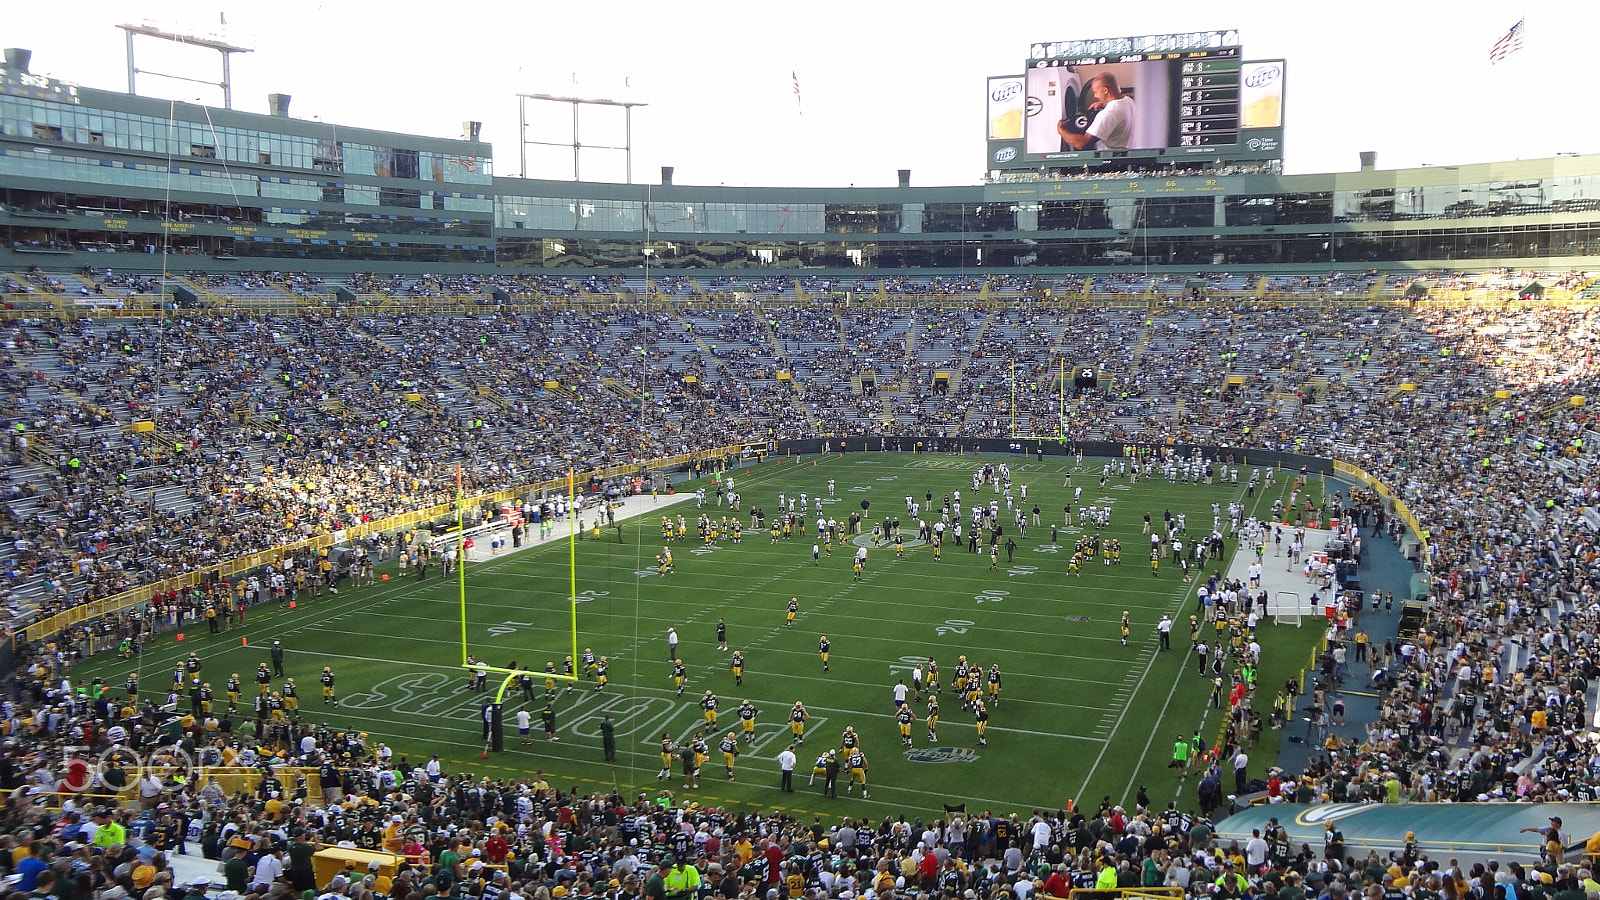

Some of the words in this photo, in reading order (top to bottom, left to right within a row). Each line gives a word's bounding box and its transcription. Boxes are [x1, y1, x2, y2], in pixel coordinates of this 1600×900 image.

[1056, 36, 1145, 55] LAMBEAU
[1155, 32, 1210, 50] FIELD
[566, 589, 610, 604] 20
[974, 590, 1011, 604] 30
[486, 620, 533, 637] 10
[935, 619, 976, 636] 20
[889, 655, 930, 675] 10
[340, 672, 829, 761] PACKERS
[851, 758, 862, 766] 67
[1577, 792, 1591, 801] 90
[975, 825, 982, 833] 7
[859, 834, 870, 845] 52
[675, 841, 687, 852] 44
[1275, 845, 1287, 857] 12
[637, 853, 648, 863] 12
[812, 859, 824, 873] 12
[790, 880, 800, 890] 21
